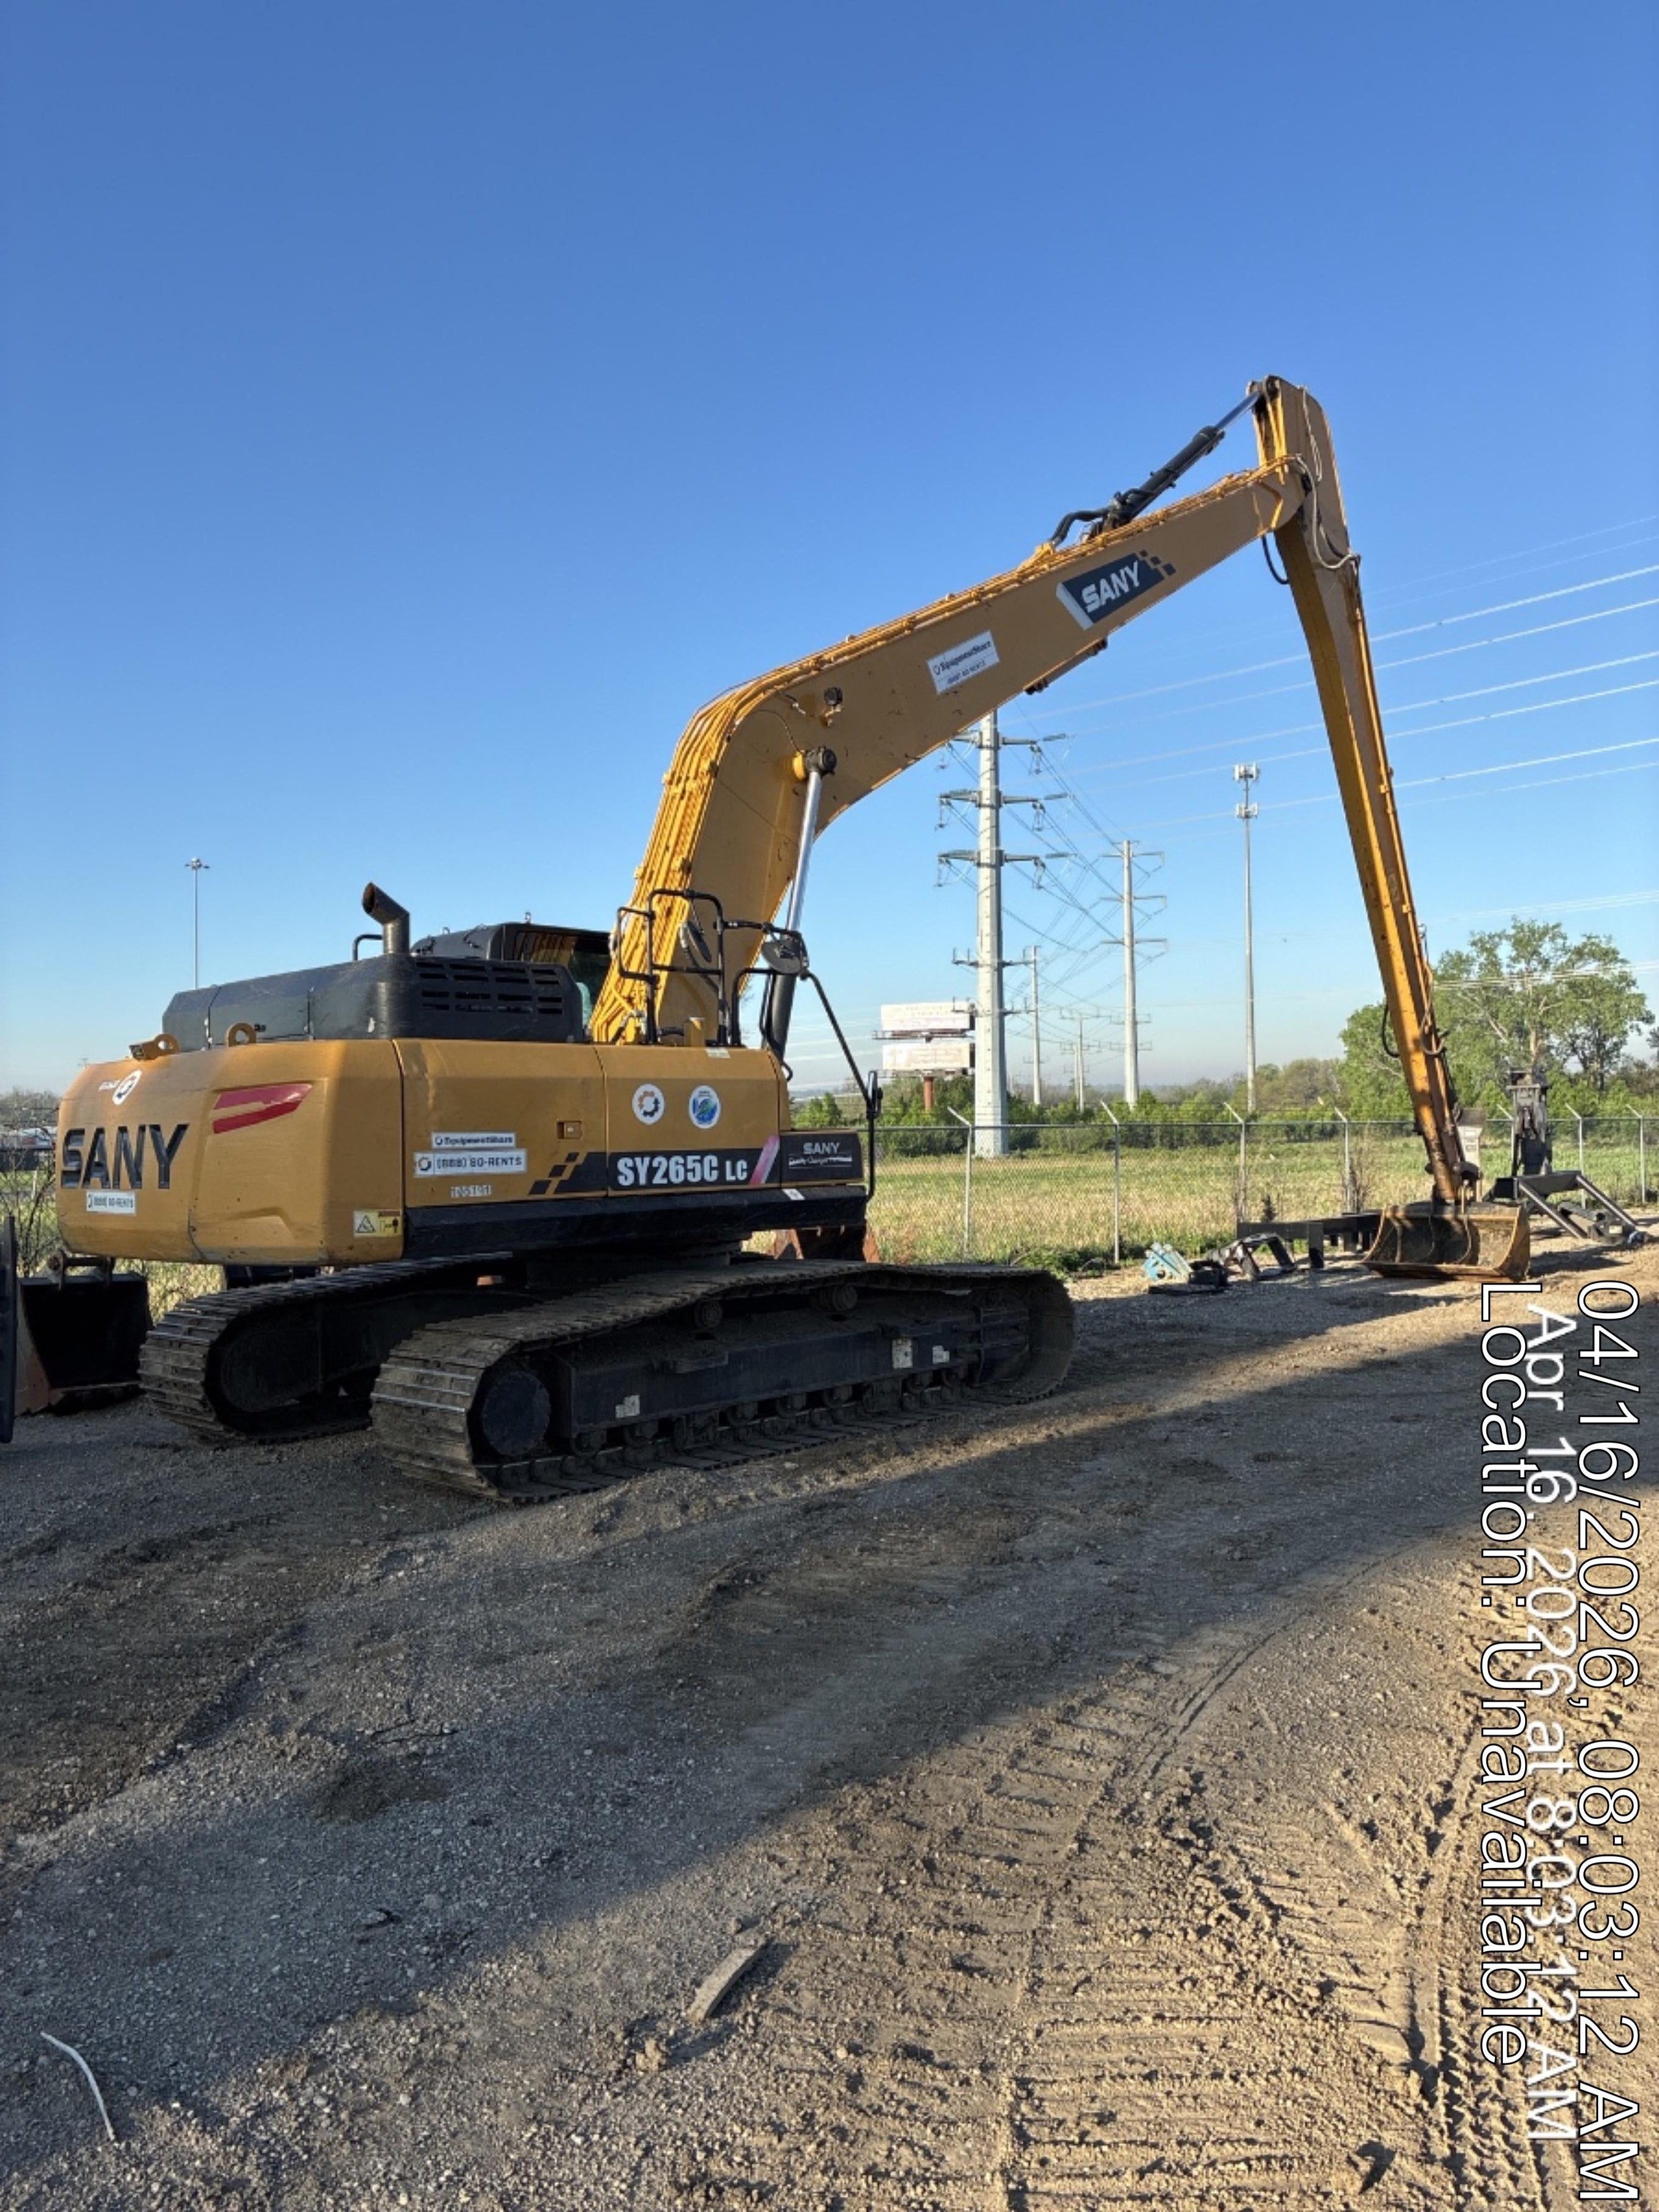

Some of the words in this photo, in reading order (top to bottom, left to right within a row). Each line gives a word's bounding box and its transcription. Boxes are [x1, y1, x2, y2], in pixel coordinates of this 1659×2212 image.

[1081, 561, 1140, 613] SANY
[61, 1124, 190, 1189] SANY
[803, 1142, 840, 1155] SANY
[617, 1155, 718, 1186] SY265C
[725, 1159, 748, 1181] LC
